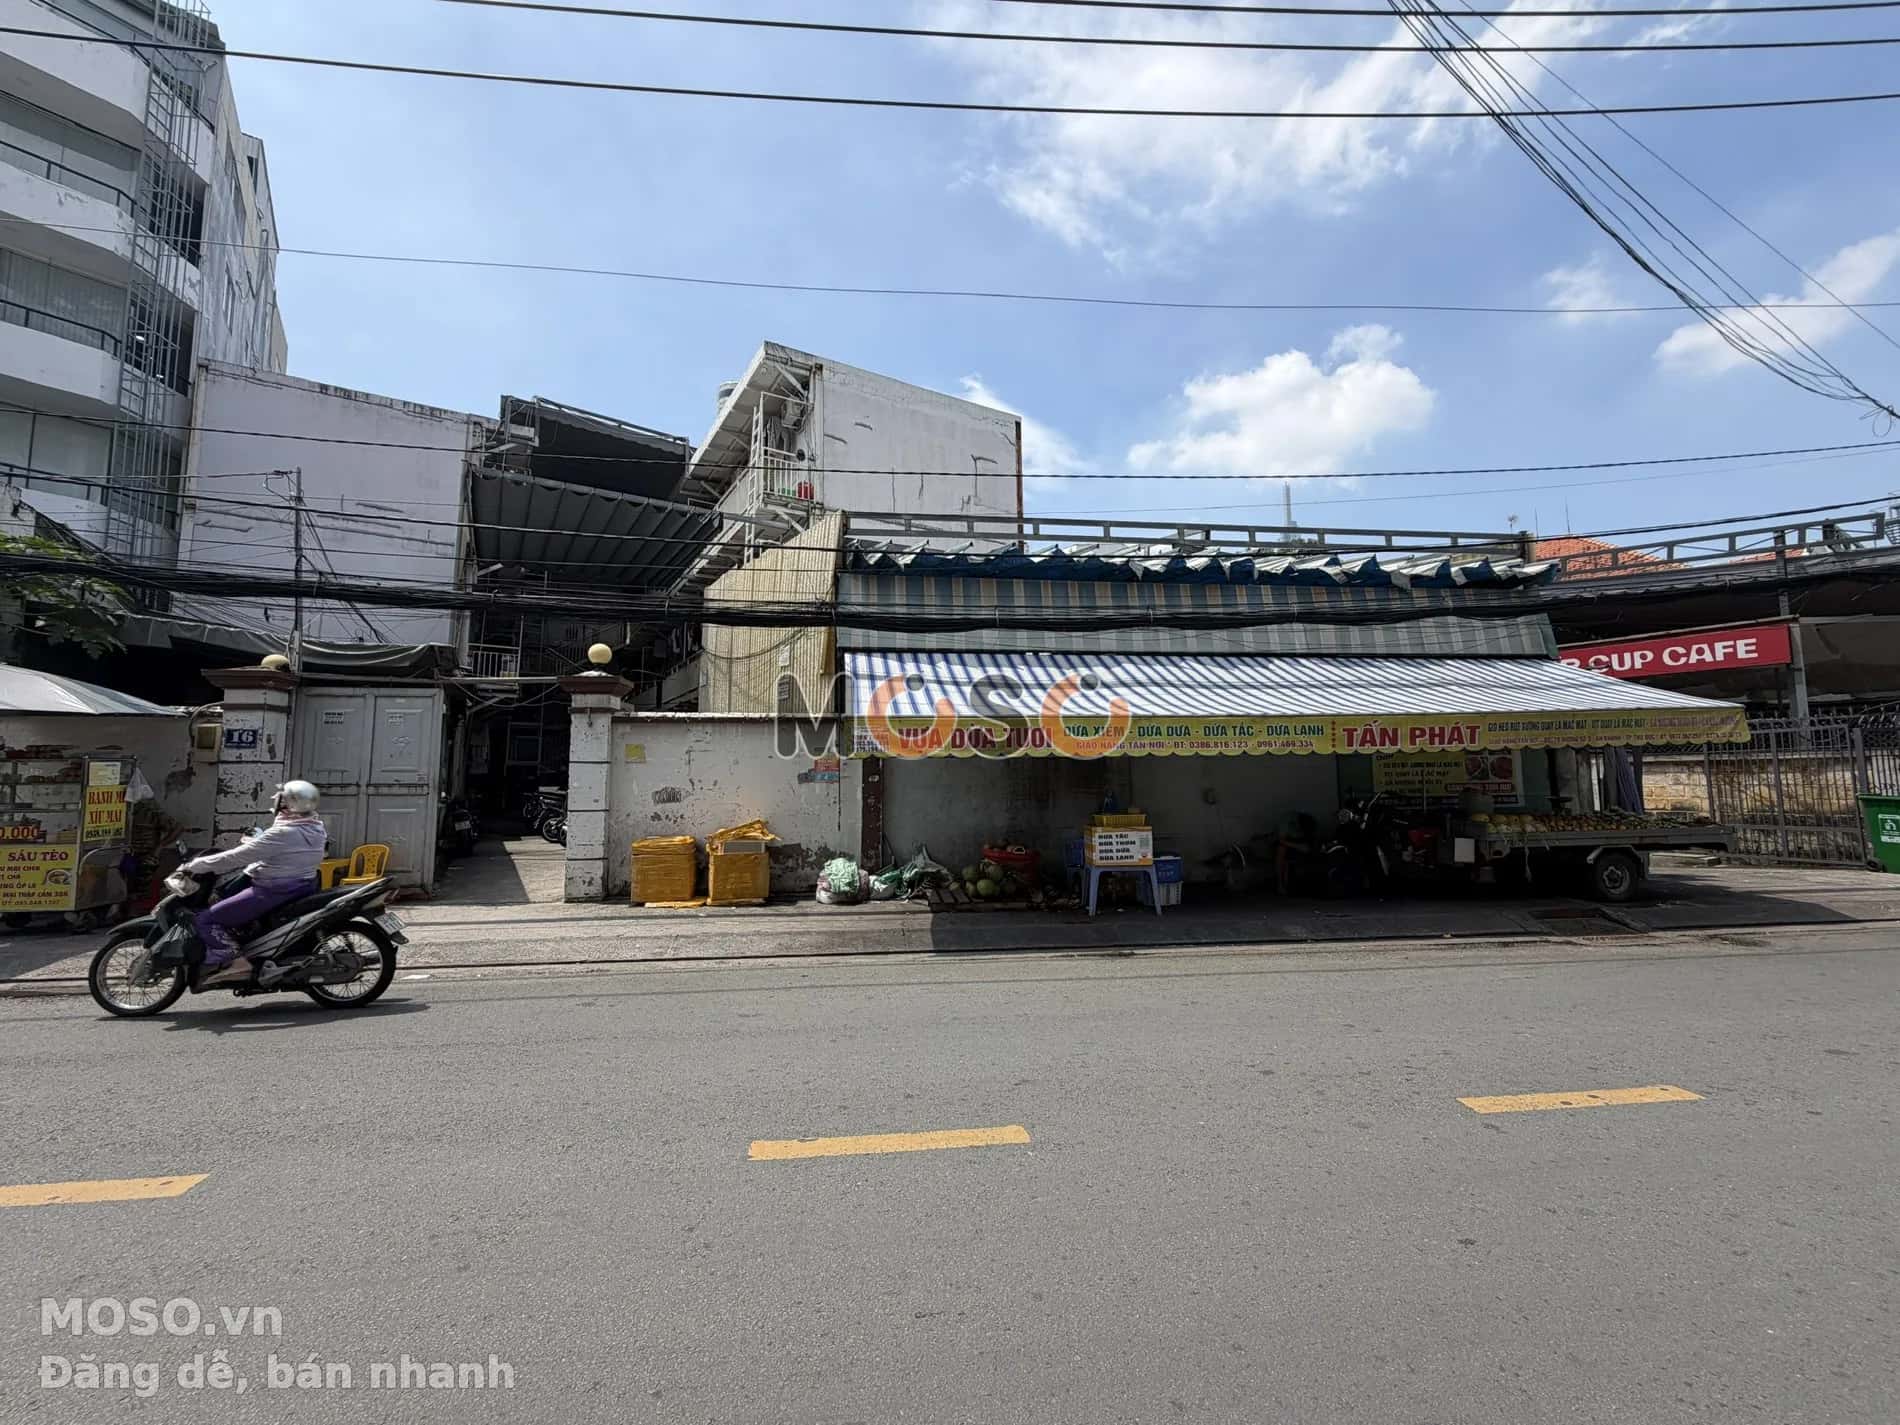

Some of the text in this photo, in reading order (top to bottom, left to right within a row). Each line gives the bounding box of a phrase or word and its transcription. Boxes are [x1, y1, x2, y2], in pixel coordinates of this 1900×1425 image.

[1588, 650, 1655, 674] CUP
[1662, 638, 1759, 667] CAFE
[231, 730, 254, 744] 16
[1342, 719, 1481, 747] TẤN PHÁT
